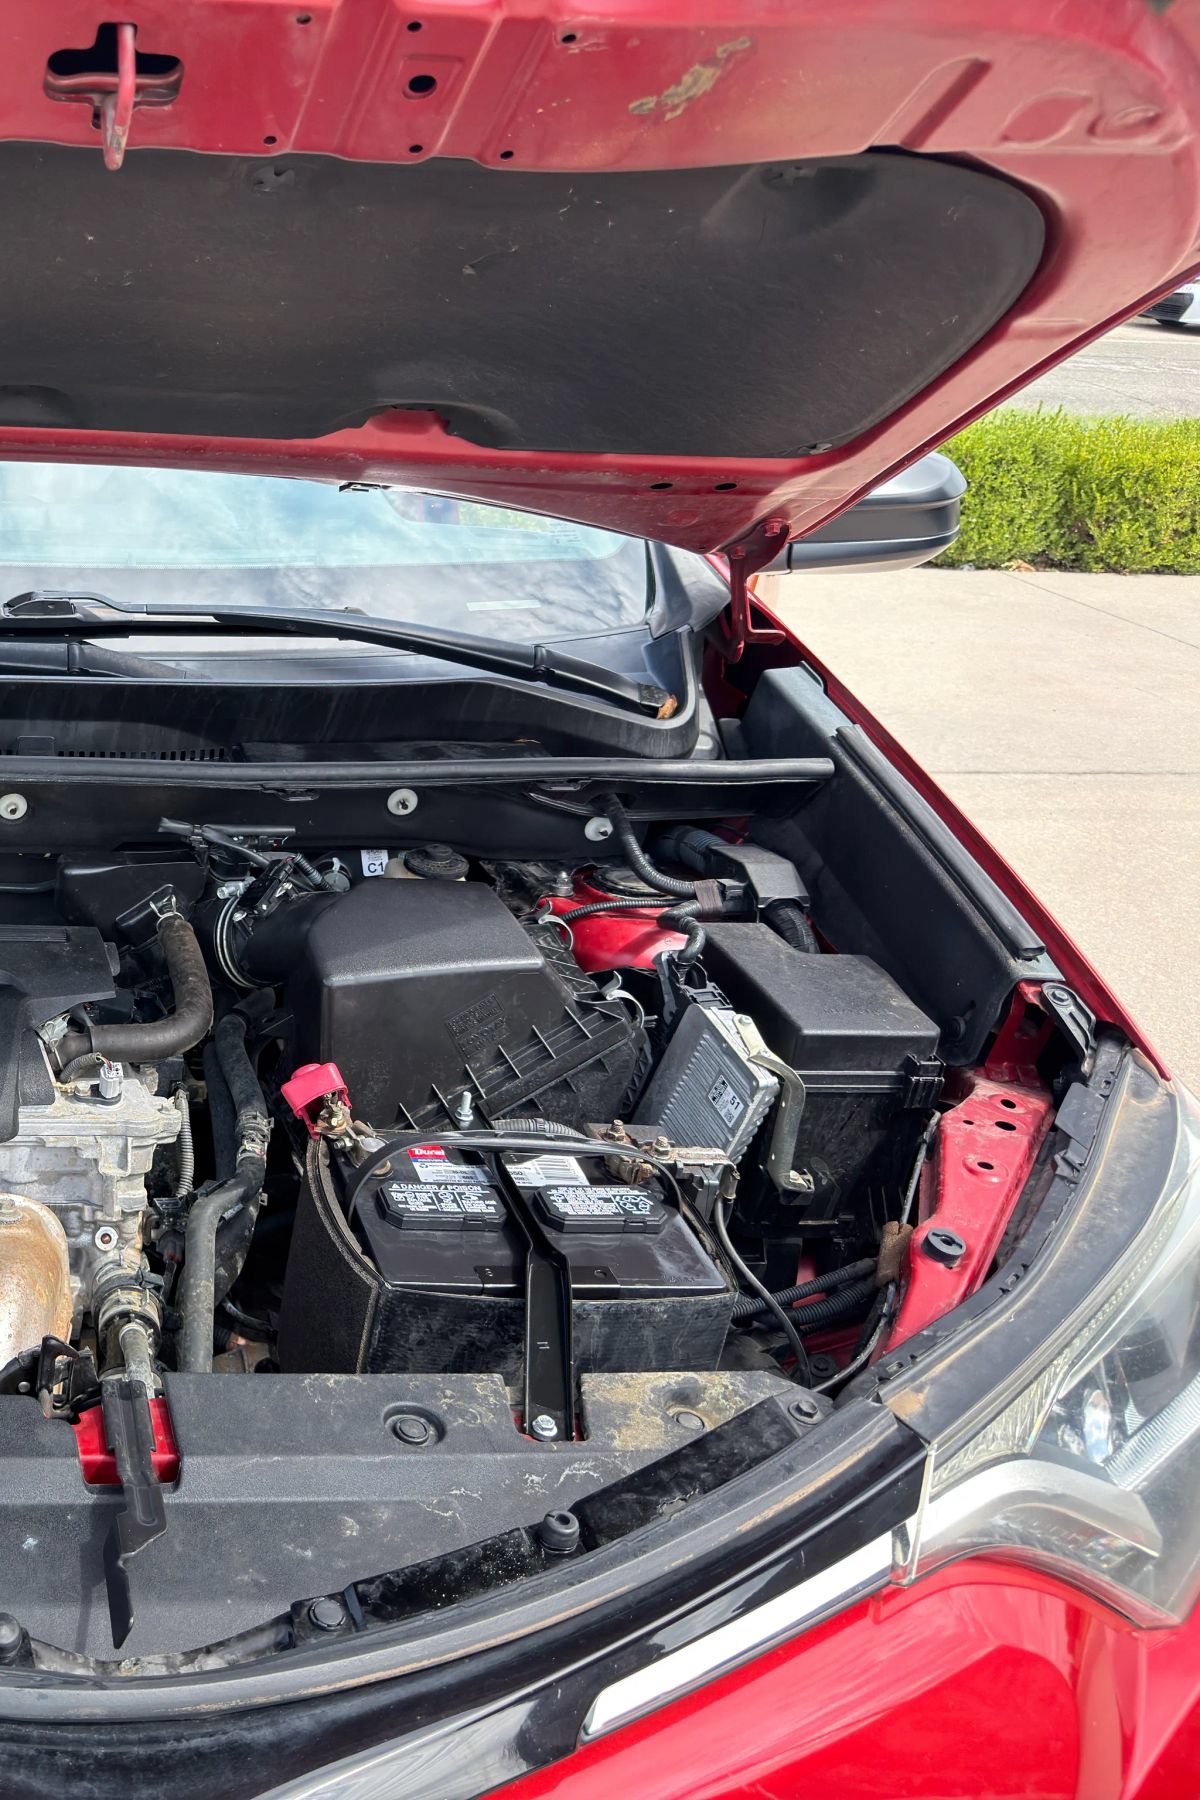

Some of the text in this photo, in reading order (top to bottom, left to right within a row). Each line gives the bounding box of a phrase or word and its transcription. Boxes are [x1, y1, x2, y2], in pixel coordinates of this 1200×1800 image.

[367, 861, 384, 874] C1
[729, 1095, 742, 1111] 51
[399, 1183, 439, 1192] DANGER
[447, 1184, 482, 1193] POISON
